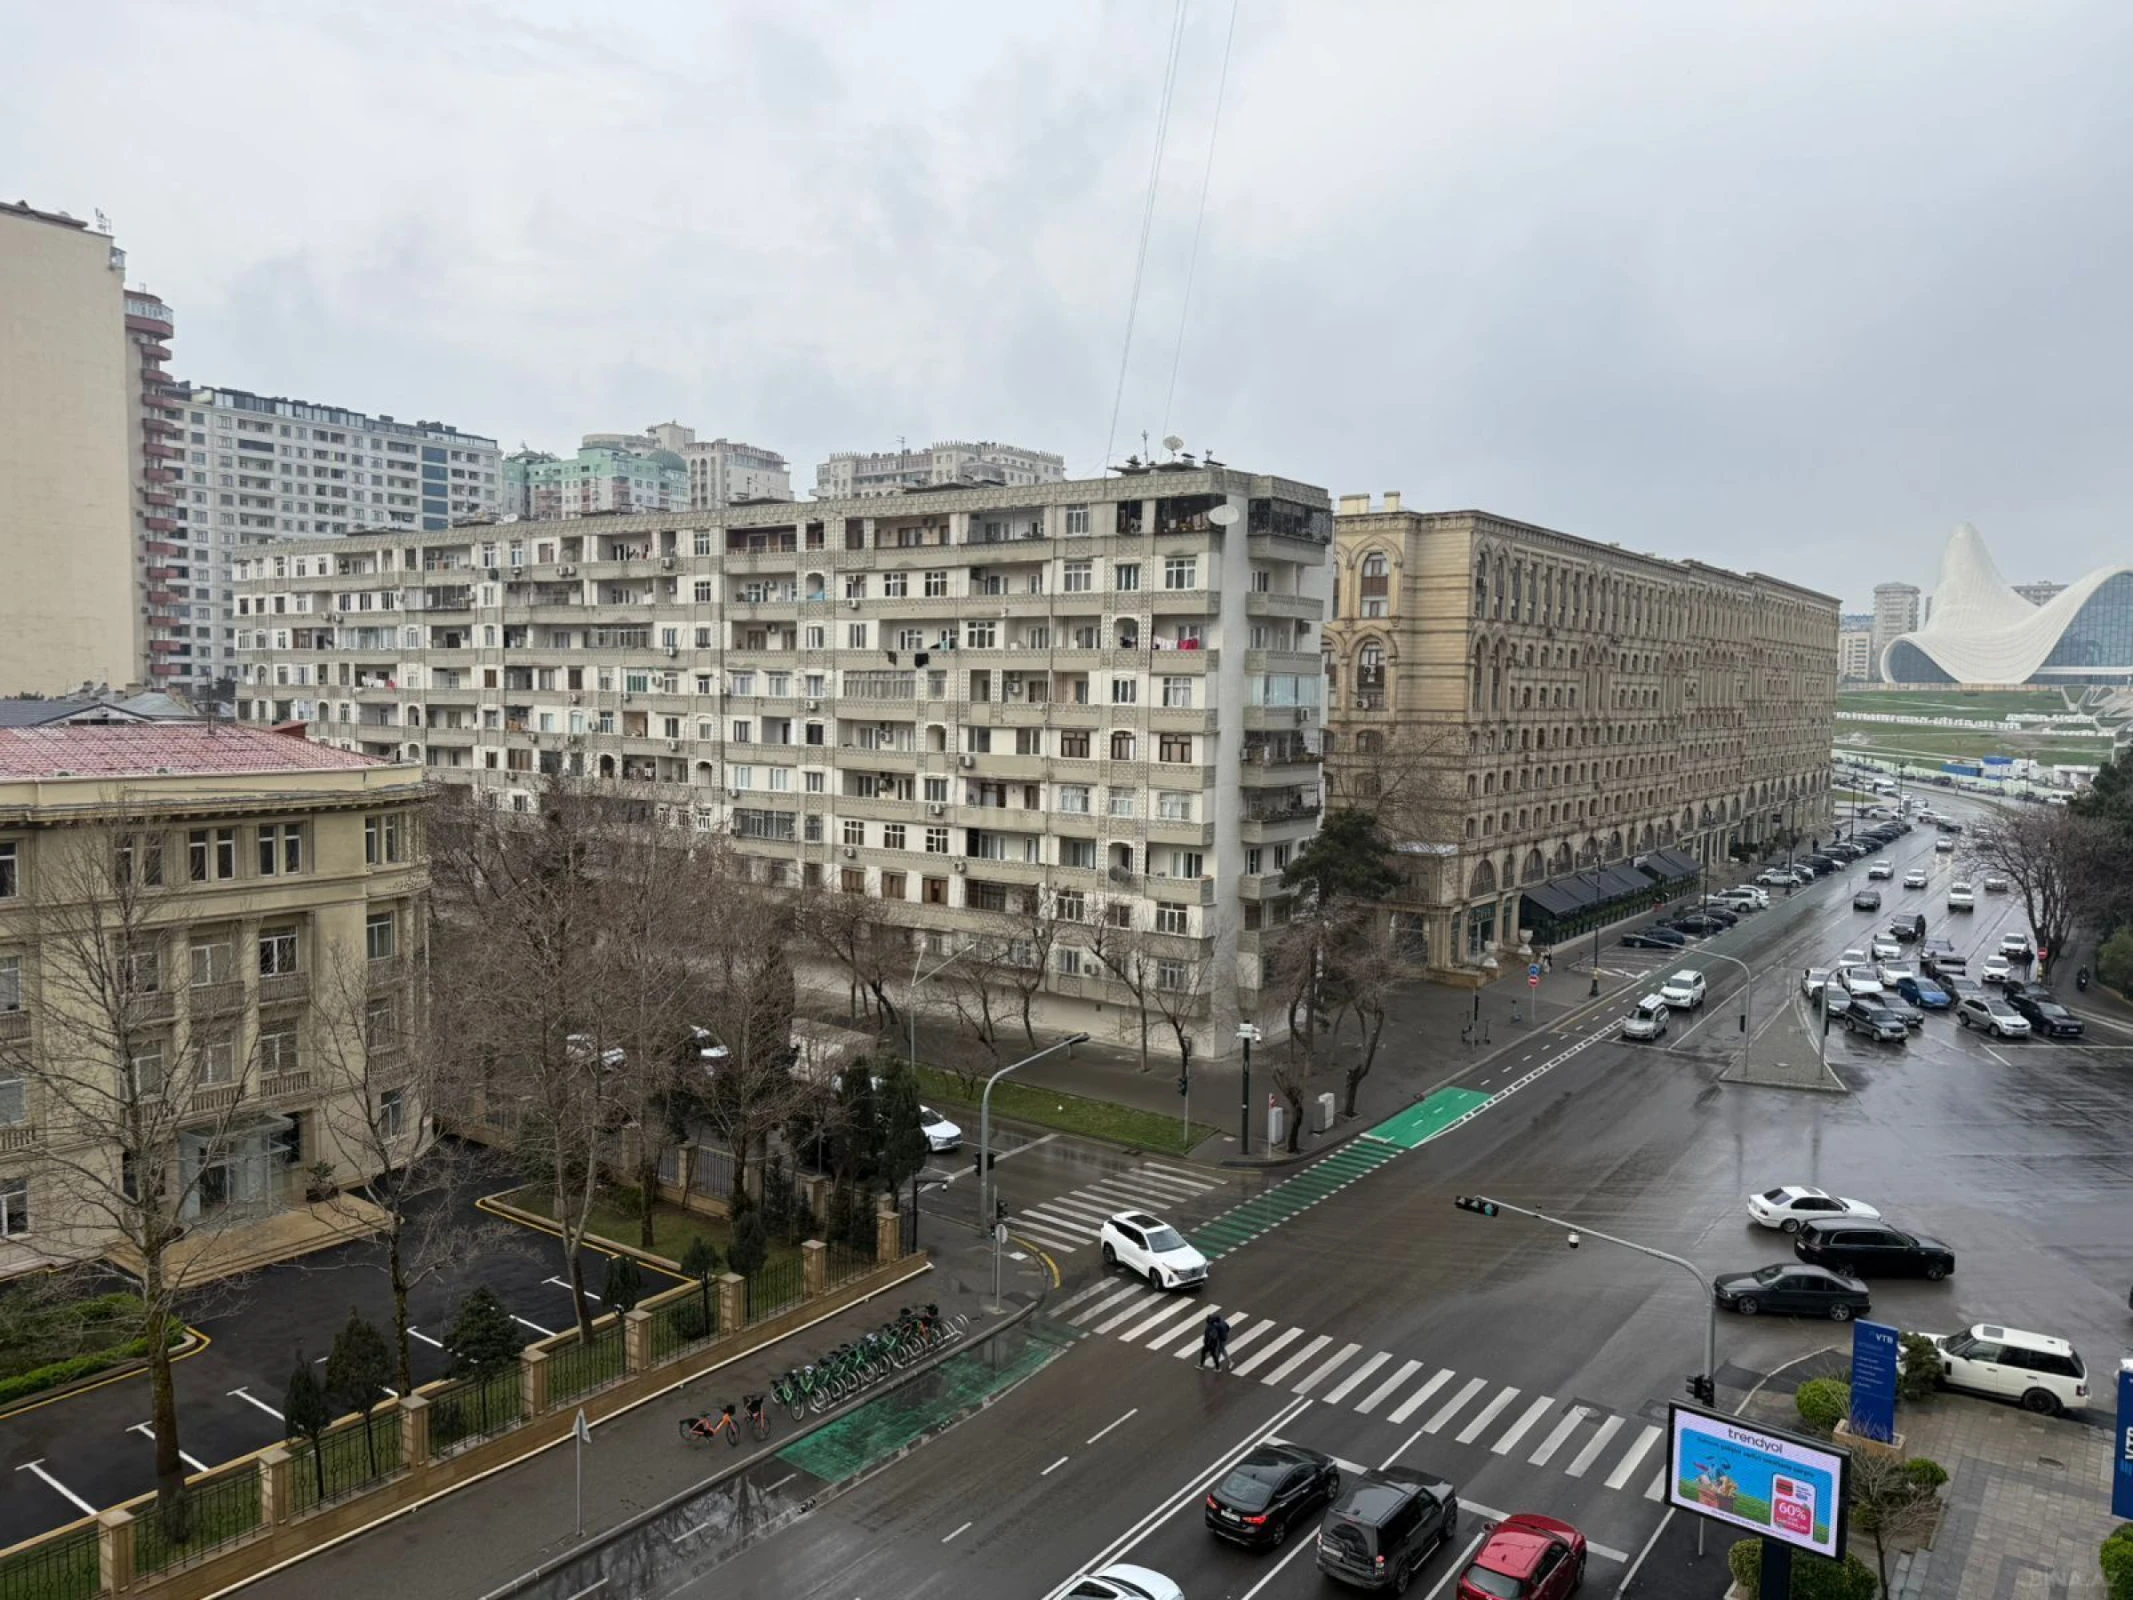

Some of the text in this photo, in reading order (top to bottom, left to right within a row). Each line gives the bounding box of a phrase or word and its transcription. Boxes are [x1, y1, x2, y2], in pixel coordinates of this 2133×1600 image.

[1875, 1332, 1894, 1345] VTB
[1728, 1428, 1783, 1454] trendyol
[1778, 1502, 1806, 1521] 60%
